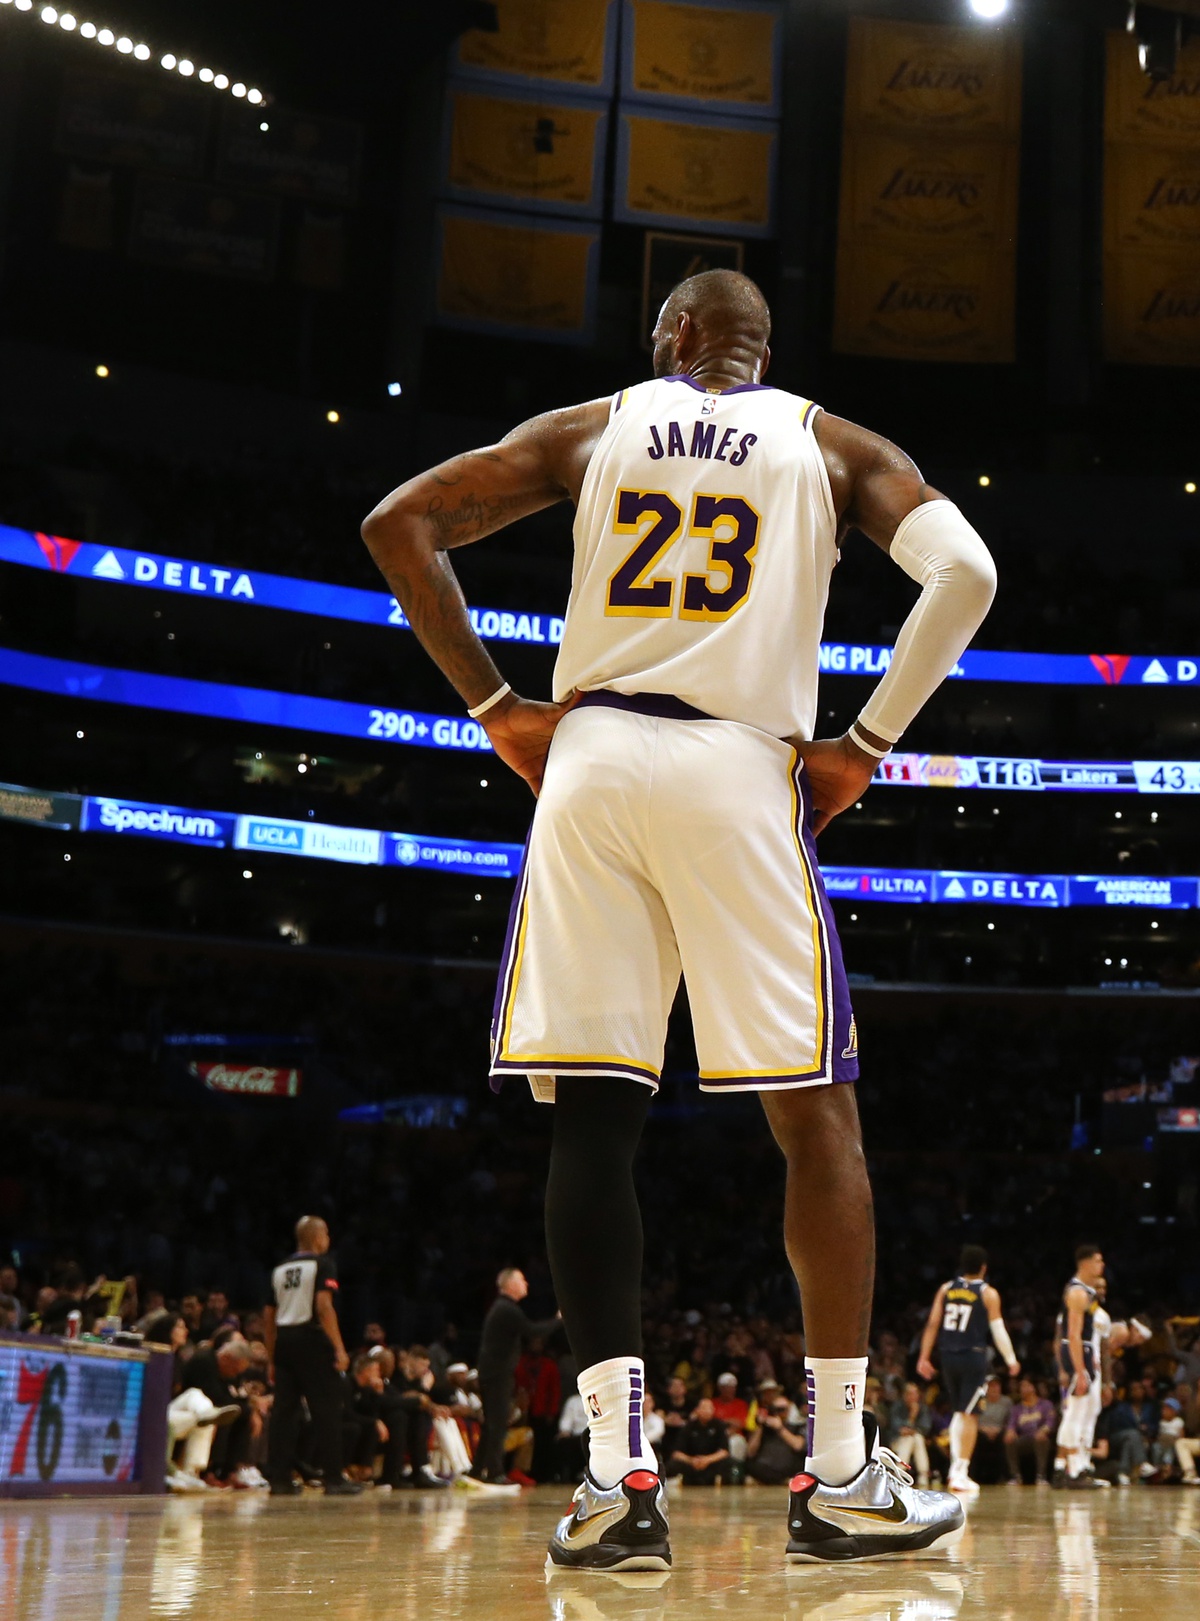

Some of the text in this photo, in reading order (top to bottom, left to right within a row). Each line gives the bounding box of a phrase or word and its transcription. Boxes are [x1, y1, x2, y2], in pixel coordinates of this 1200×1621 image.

[647, 421, 758, 467] JAMES
[604, 486, 763, 623] 23
[134, 556, 255, 599] DELTA
[468, 609, 546, 643] LOBAL
[367, 708, 494, 751] 290+ GLOB
[983, 761, 1033, 786] 116
[1061, 769, 1118, 785] Lakers
[100, 801, 216, 837] Spectrum
[253, 825, 373, 855] UCLA Health
[421, 843, 509, 867] crypto.com
[871, 877, 927, 894] ULTRA
[972, 879, 1058, 900] DELTA
[1095, 880, 1171, 893] AMERICAN
[1105, 891, 1172, 905] EXPRESS
[943, 1303, 973, 1333] 27
